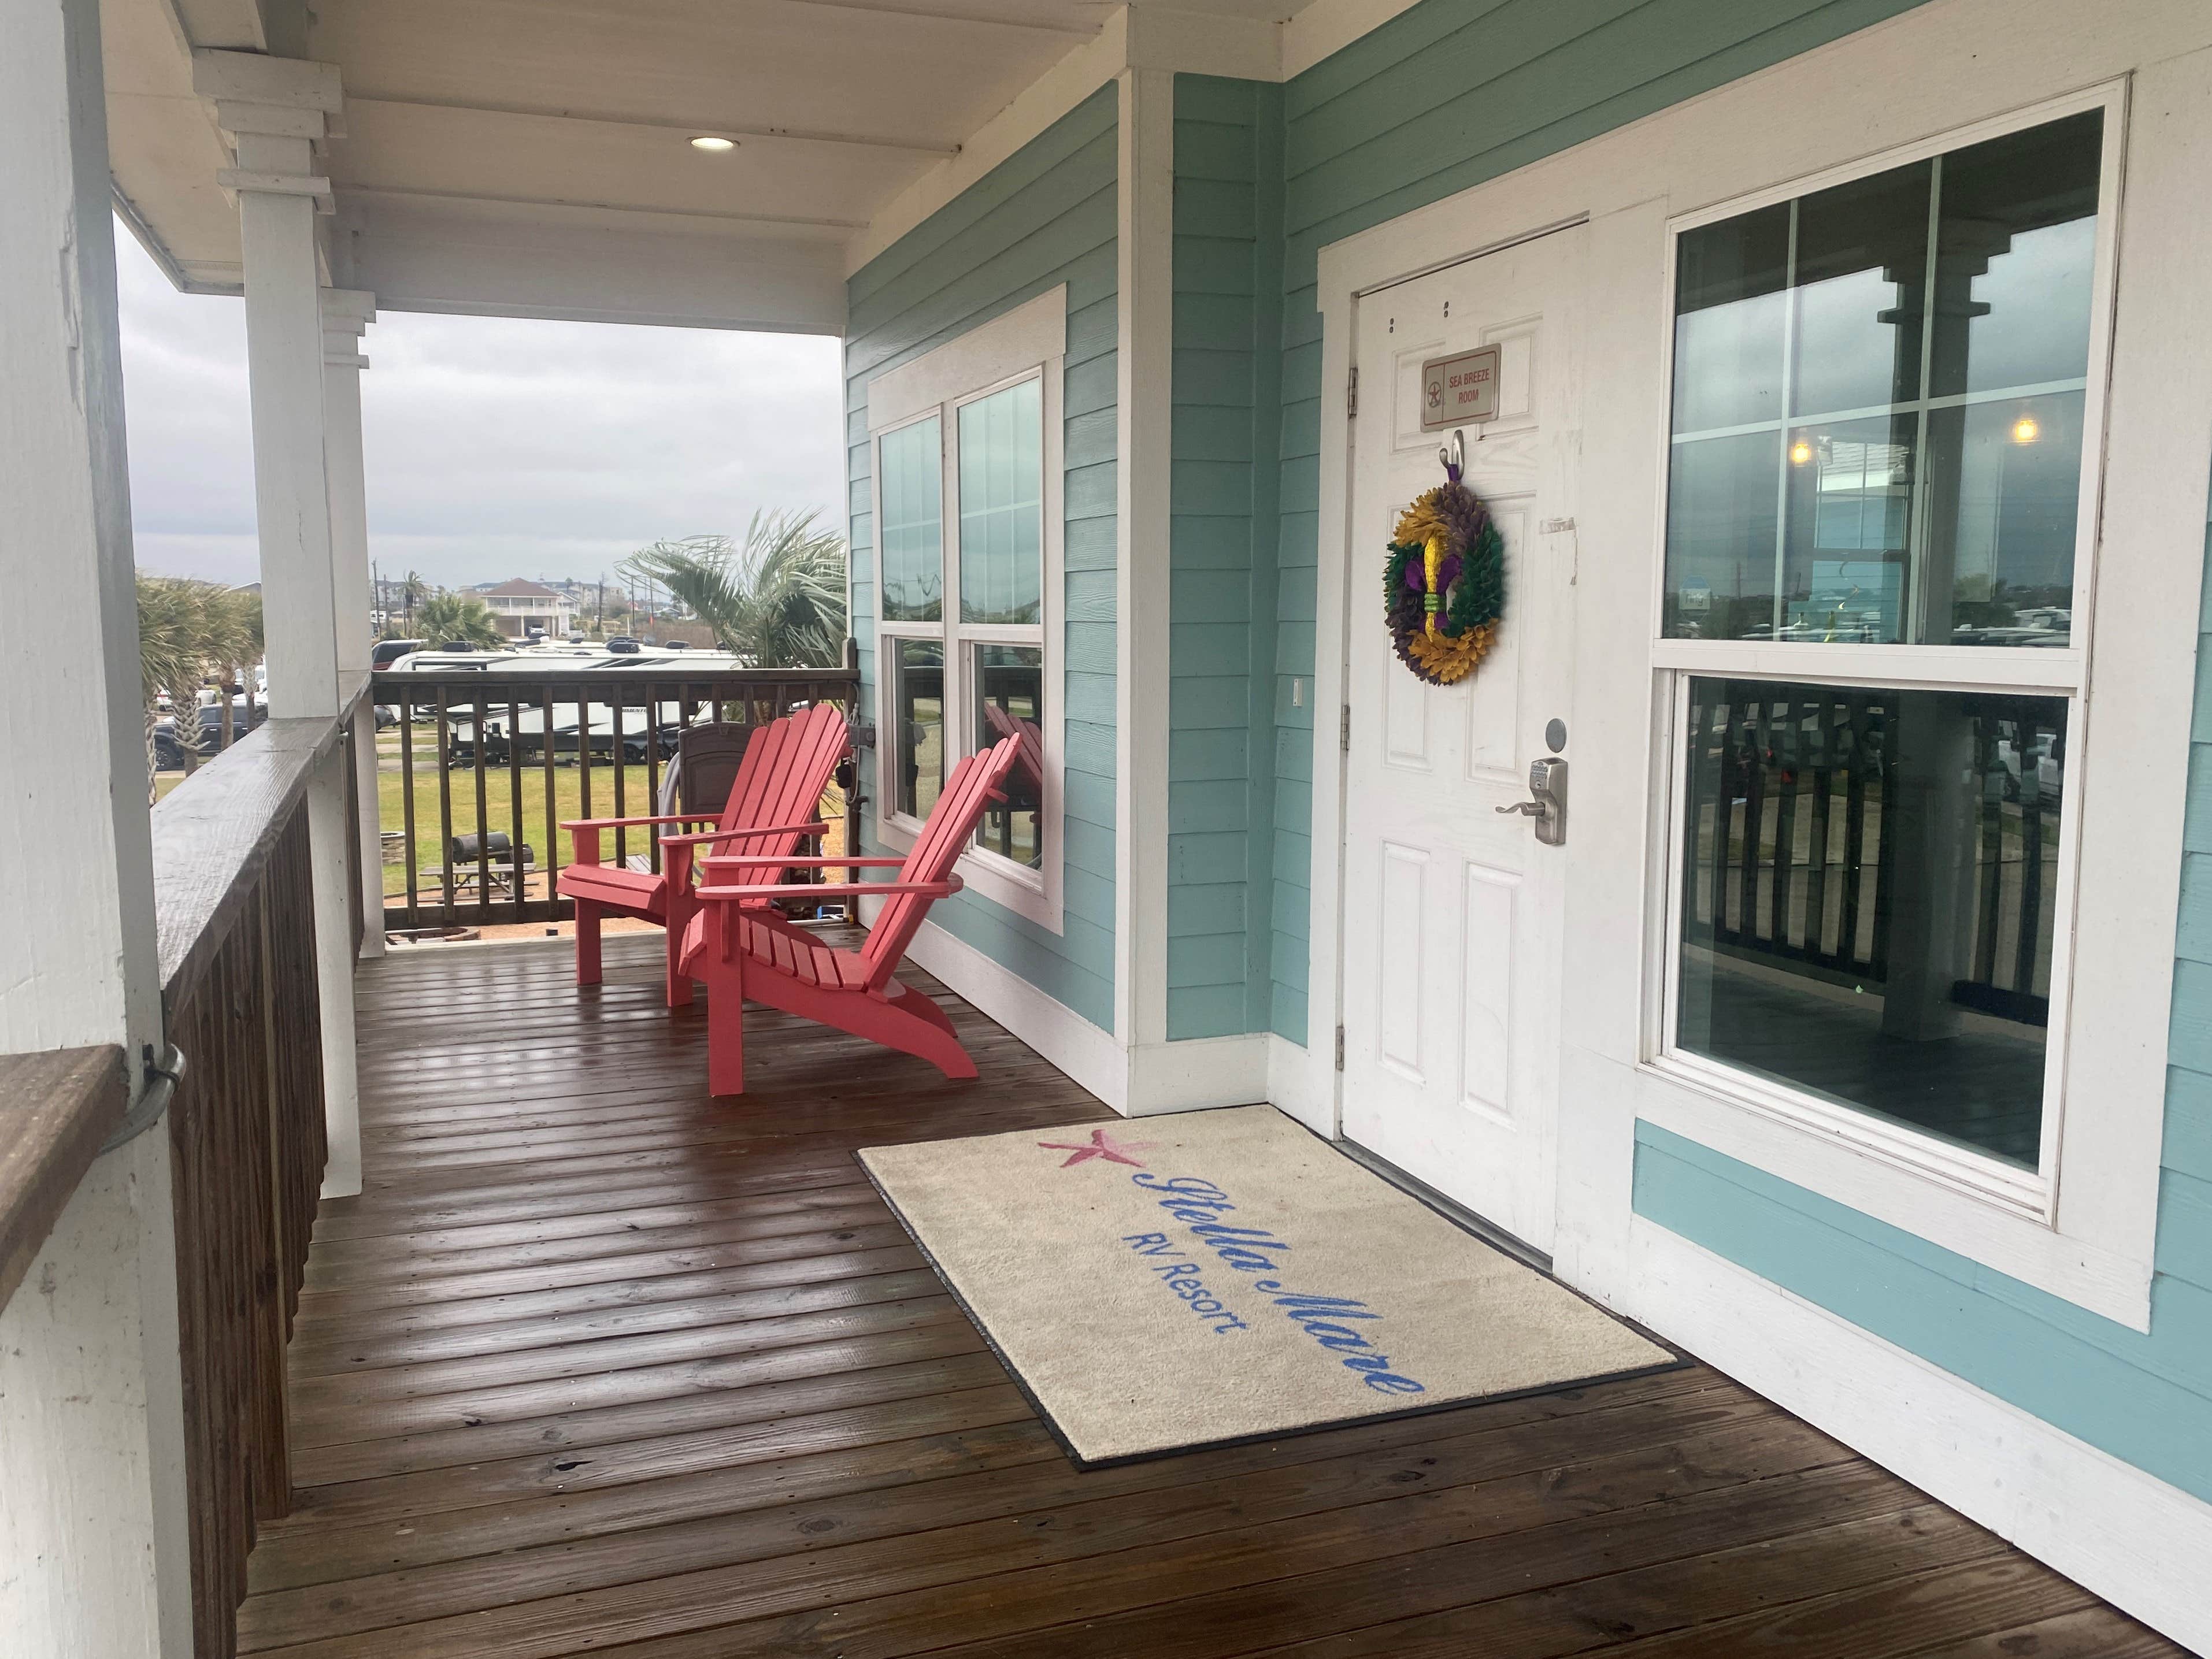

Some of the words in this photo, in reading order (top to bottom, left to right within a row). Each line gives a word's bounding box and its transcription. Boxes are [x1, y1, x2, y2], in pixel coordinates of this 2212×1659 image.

[1449, 374, 1462, 388] SEA
[1463, 368, 1490, 385] BREEZE
[1458, 388, 1479, 404] ROOM
[1122, 1231, 1185, 1256] RV
[1131, 1172, 1292, 1271] Stella
[1254, 1280, 1425, 1394] Mare
[1152, 1262, 1251, 1334] Resort
